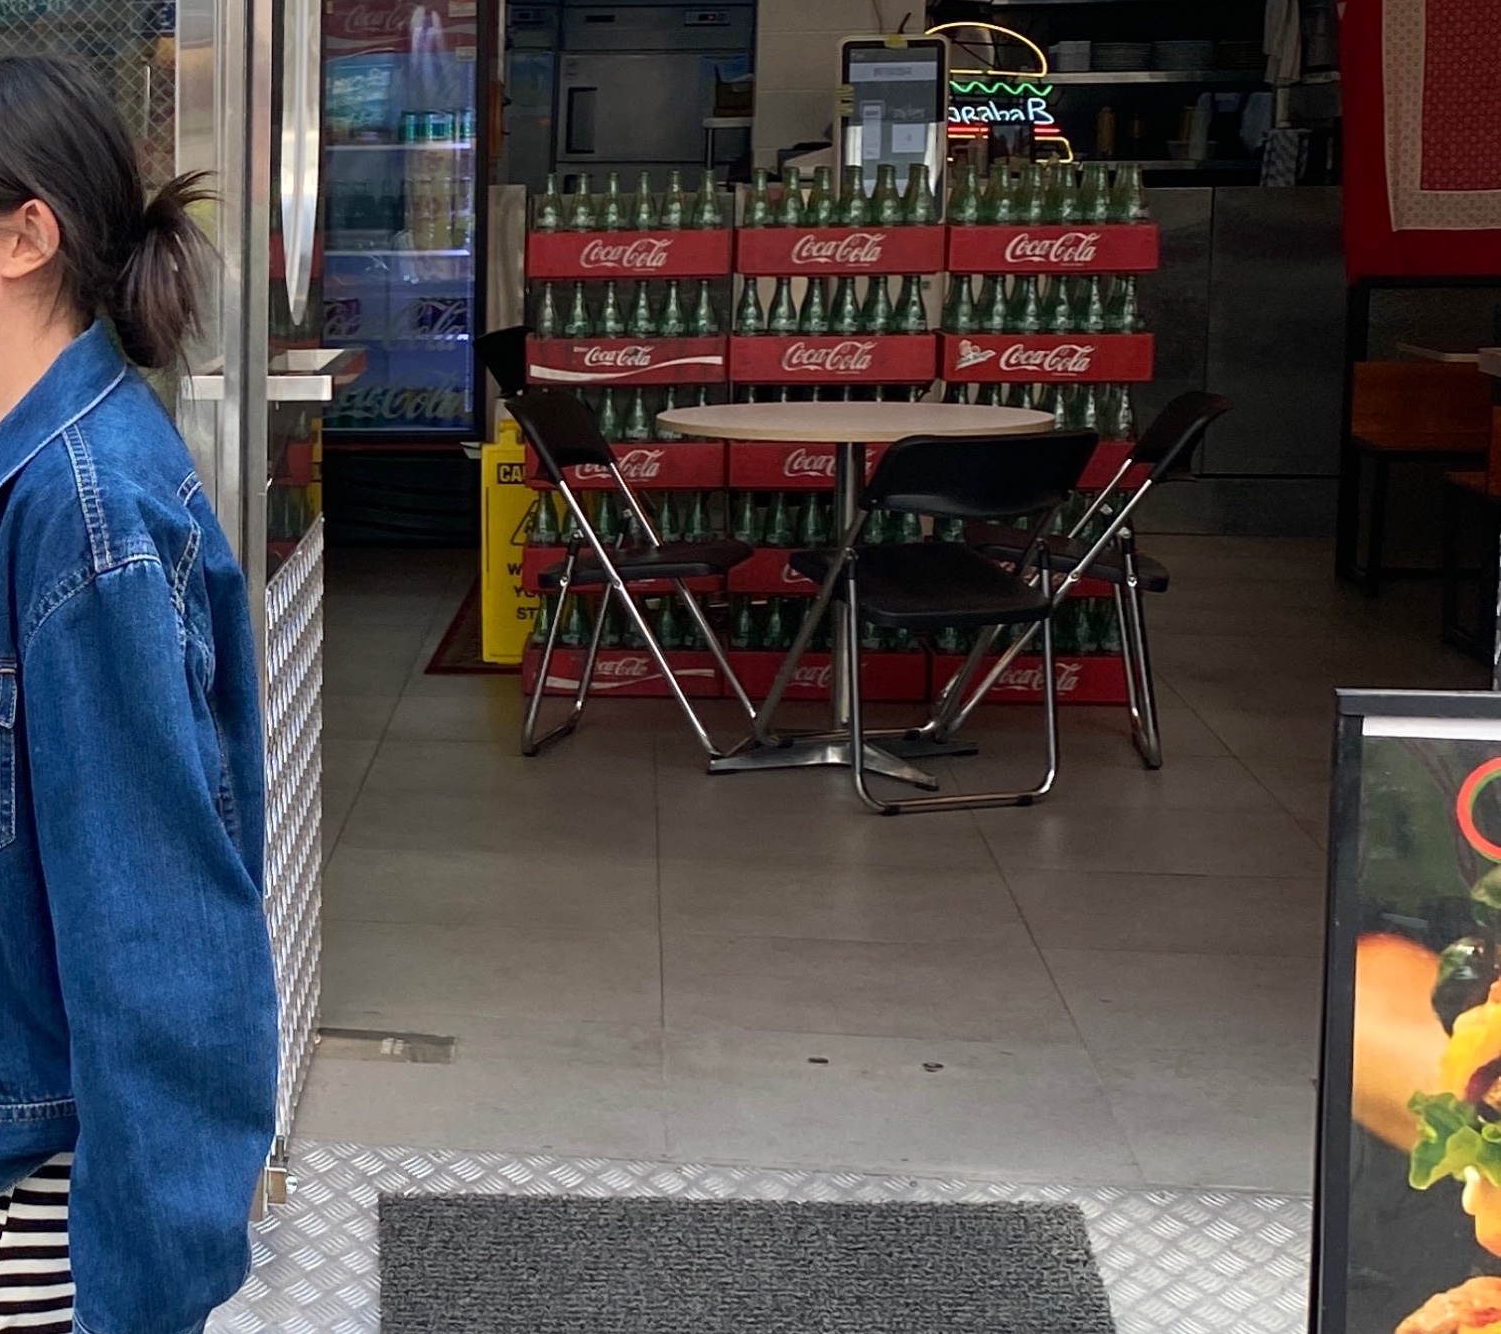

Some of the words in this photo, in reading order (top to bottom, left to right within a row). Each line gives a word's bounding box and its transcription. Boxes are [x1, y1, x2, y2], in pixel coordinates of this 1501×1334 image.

[580, 238, 673, 269] Coca-Cola
[792, 234, 887, 264] Coca-Cola
[1005, 233, 1101, 264] Coca-Cola
[584, 346, 654, 367] Coca-Cola
[782, 341, 878, 372] Coca-Cola
[1000, 344, 1096, 373] Coca-Cola
